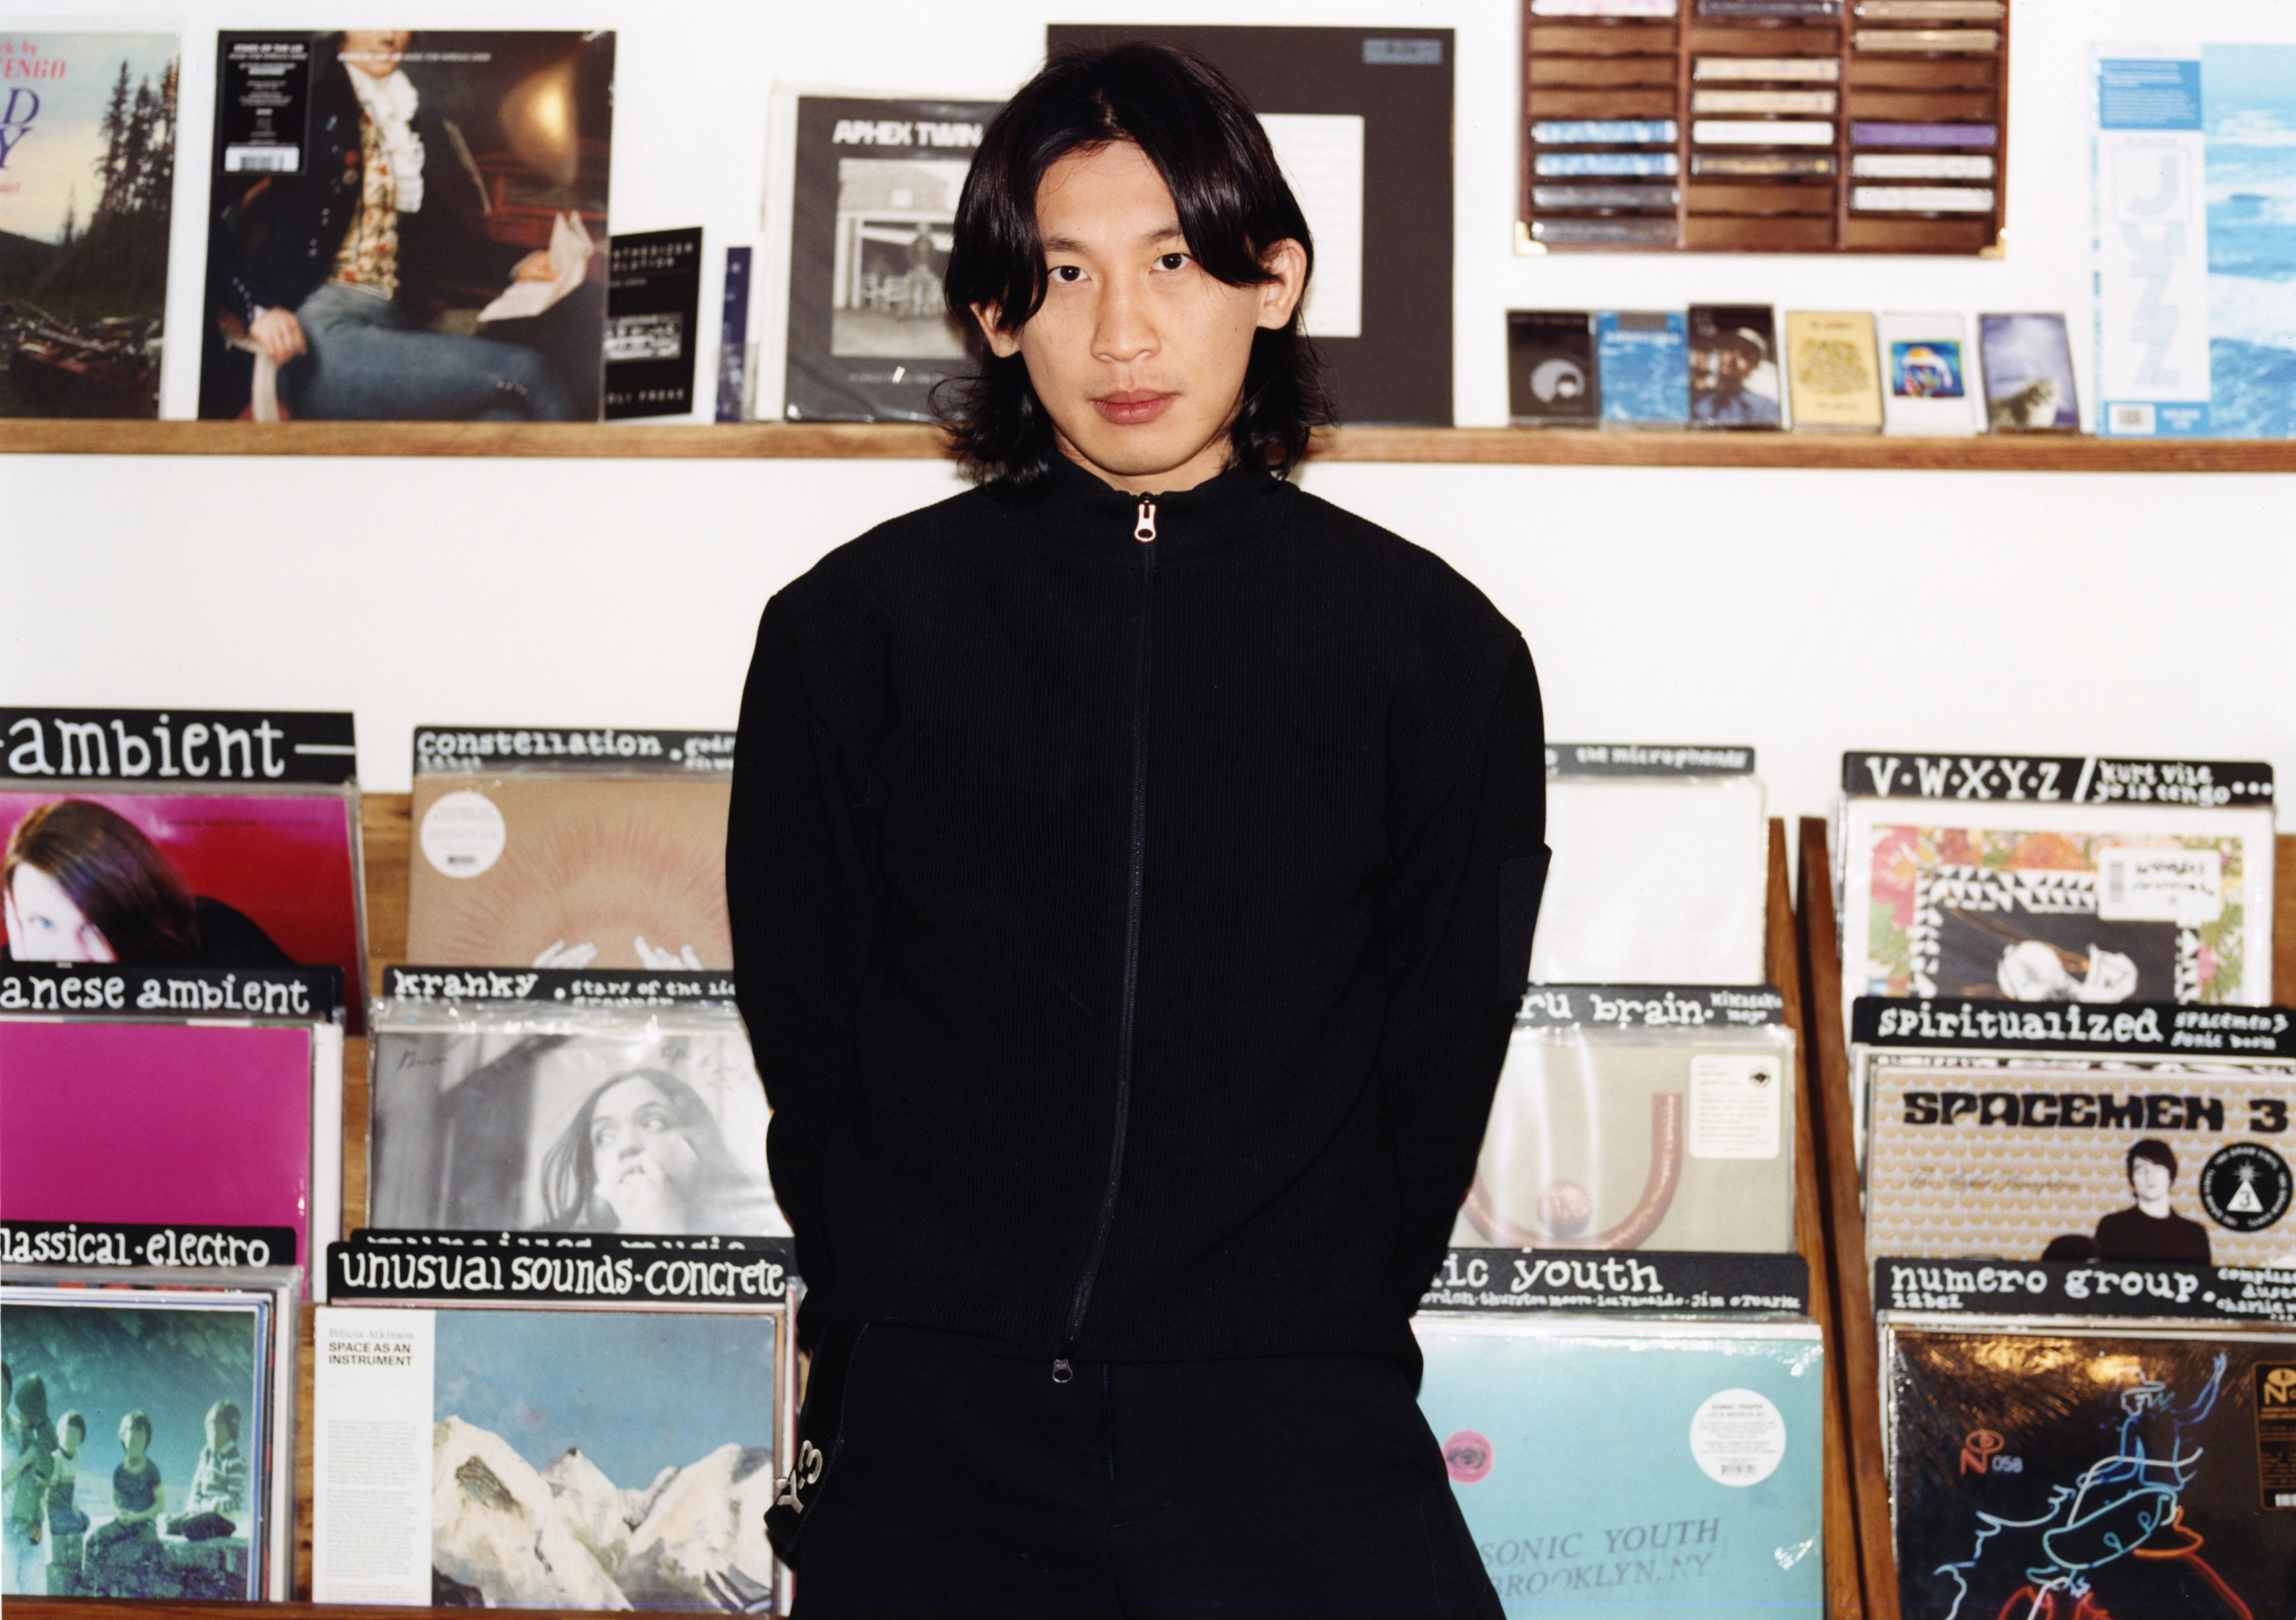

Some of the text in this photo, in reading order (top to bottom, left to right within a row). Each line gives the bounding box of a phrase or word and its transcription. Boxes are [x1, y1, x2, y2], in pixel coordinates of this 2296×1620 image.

[832, 119, 984, 147] APHEX TWIN
[8, 713, 286, 778] ambient
[417, 730, 664, 756] constellation
[2098, 760, 2157, 785] kurt
[2160, 761, 2214, 786] vile
[2092, 781, 2232, 808] yo la tengo
[0, 974, 310, 1015] anese ambient
[394, 968, 539, 999] kranky
[571, 979, 631, 997] stars
[636, 980, 661, 997] of
[665, 980, 703, 997] the
[1877, 1002, 2164, 1043] spiritualized
[2170, 1030, 2277, 1051] sonic boom
[1902, 1092, 2289, 1133] SPACEMEN 3
[2239, 1190, 2251, 1208] 3
[0, 1224, 270, 1268] lassical·electro
[338, 1252, 505, 1290] unusual
[1510, 1256, 1665, 1294] youth
[1890, 1265, 2048, 1294] numero
[1893, 1292, 1965, 1310] label
[328, 1342, 411, 1354] SPACE AS AN
[328, 1354, 412, 1366] INSTRUMENT
[1991, 1454, 2024, 1474] 058
[1479, 1518, 1721, 1566] SONIC YOUTH
